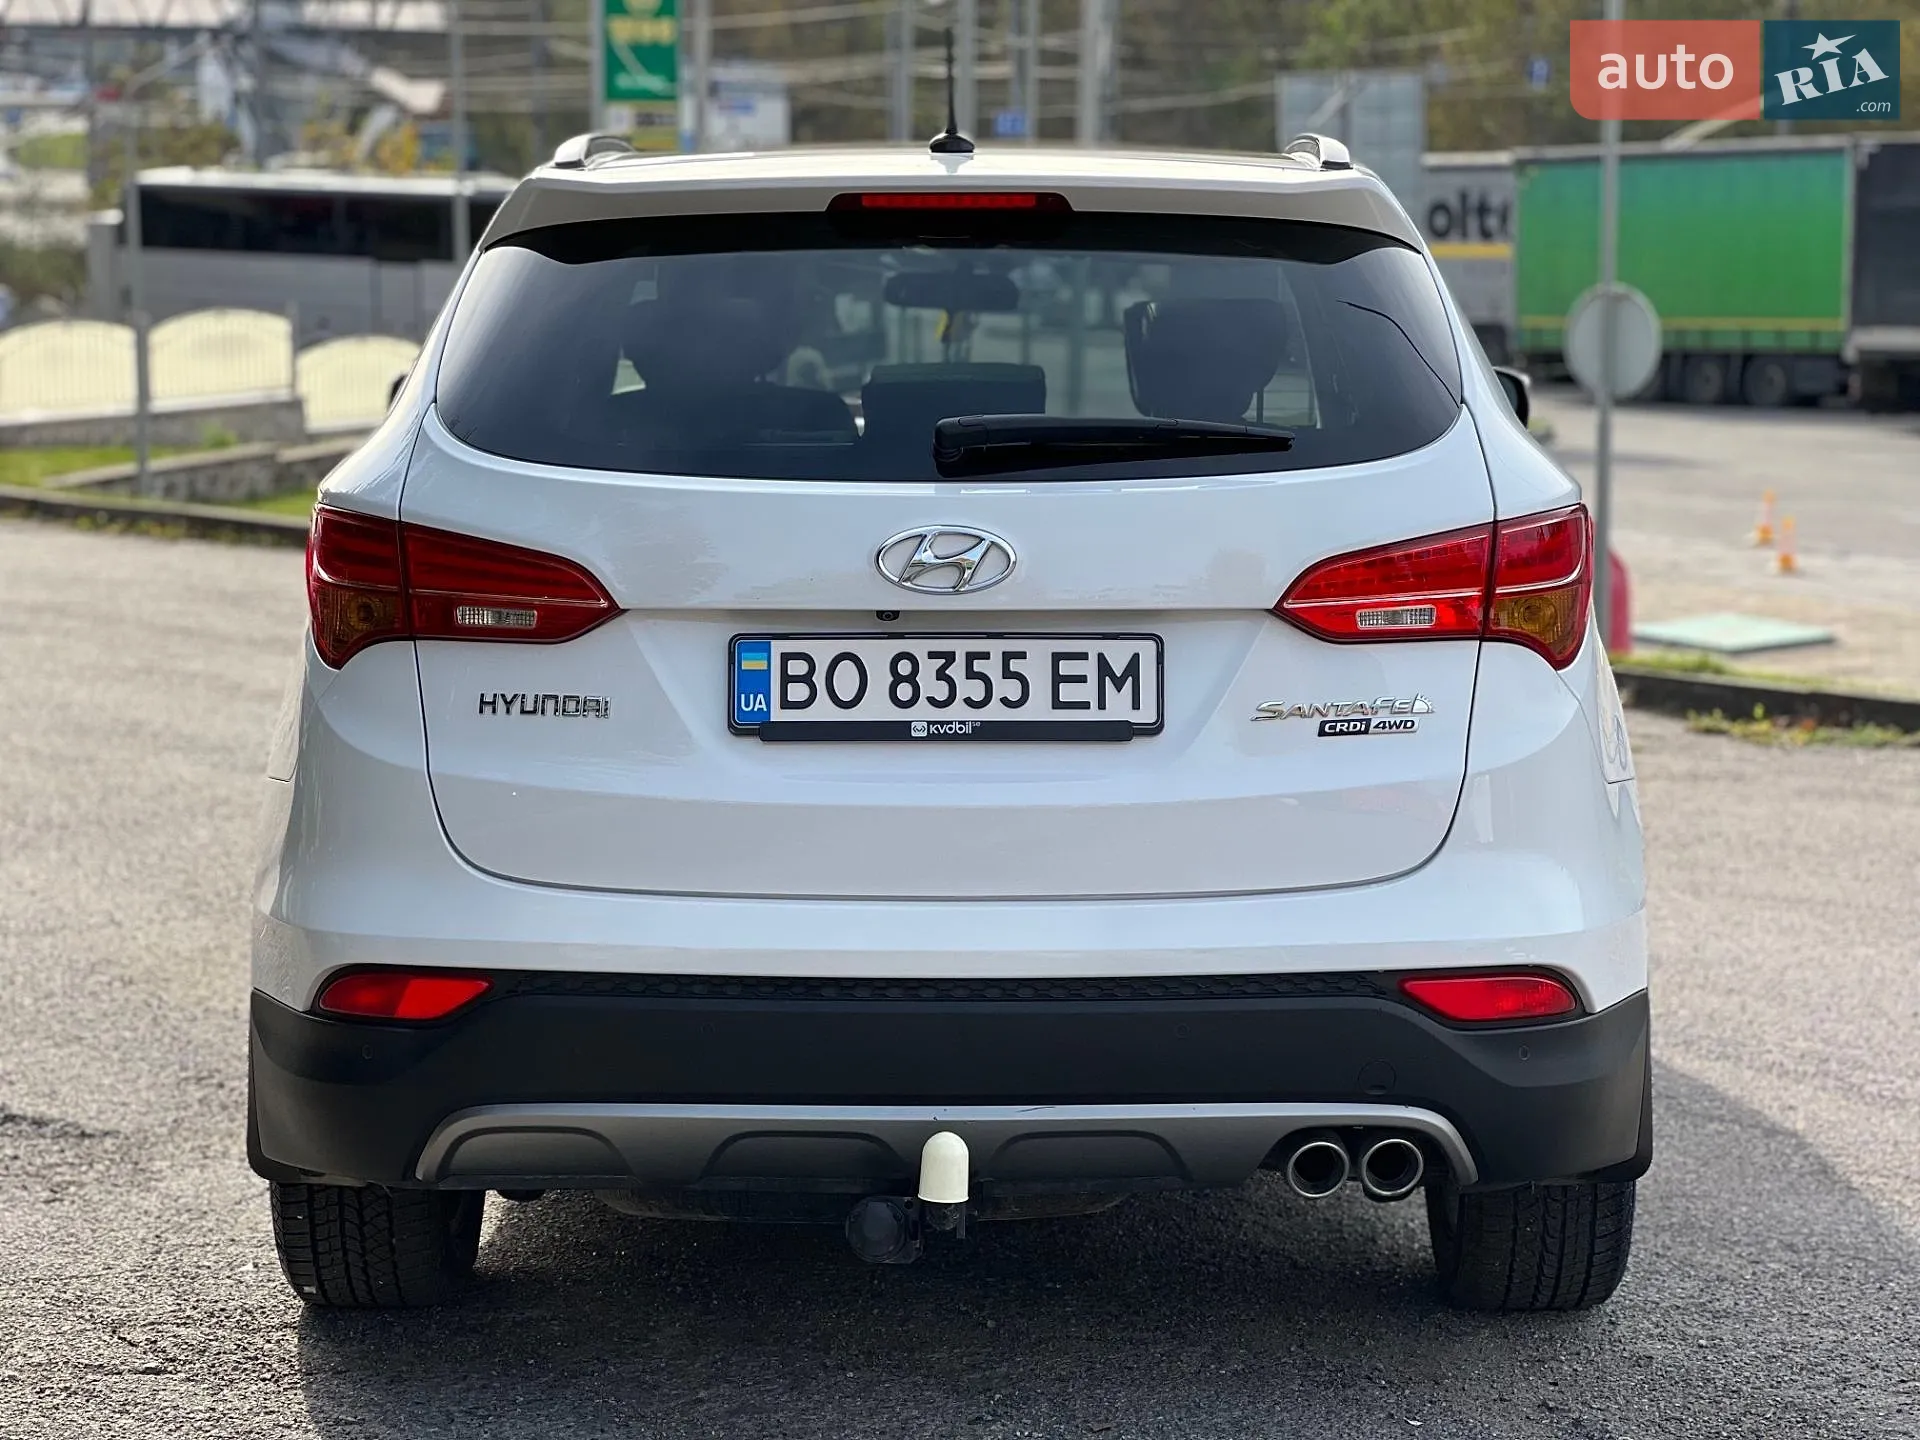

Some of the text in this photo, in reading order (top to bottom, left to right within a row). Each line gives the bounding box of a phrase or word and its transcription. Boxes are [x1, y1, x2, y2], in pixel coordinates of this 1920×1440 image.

[780, 651, 1141, 711] BO 8355 EM
[479, 693, 610, 719] HYUNDAI
[741, 693, 767, 712] UA
[1324, 718, 1415, 734] CRDi 4WD
